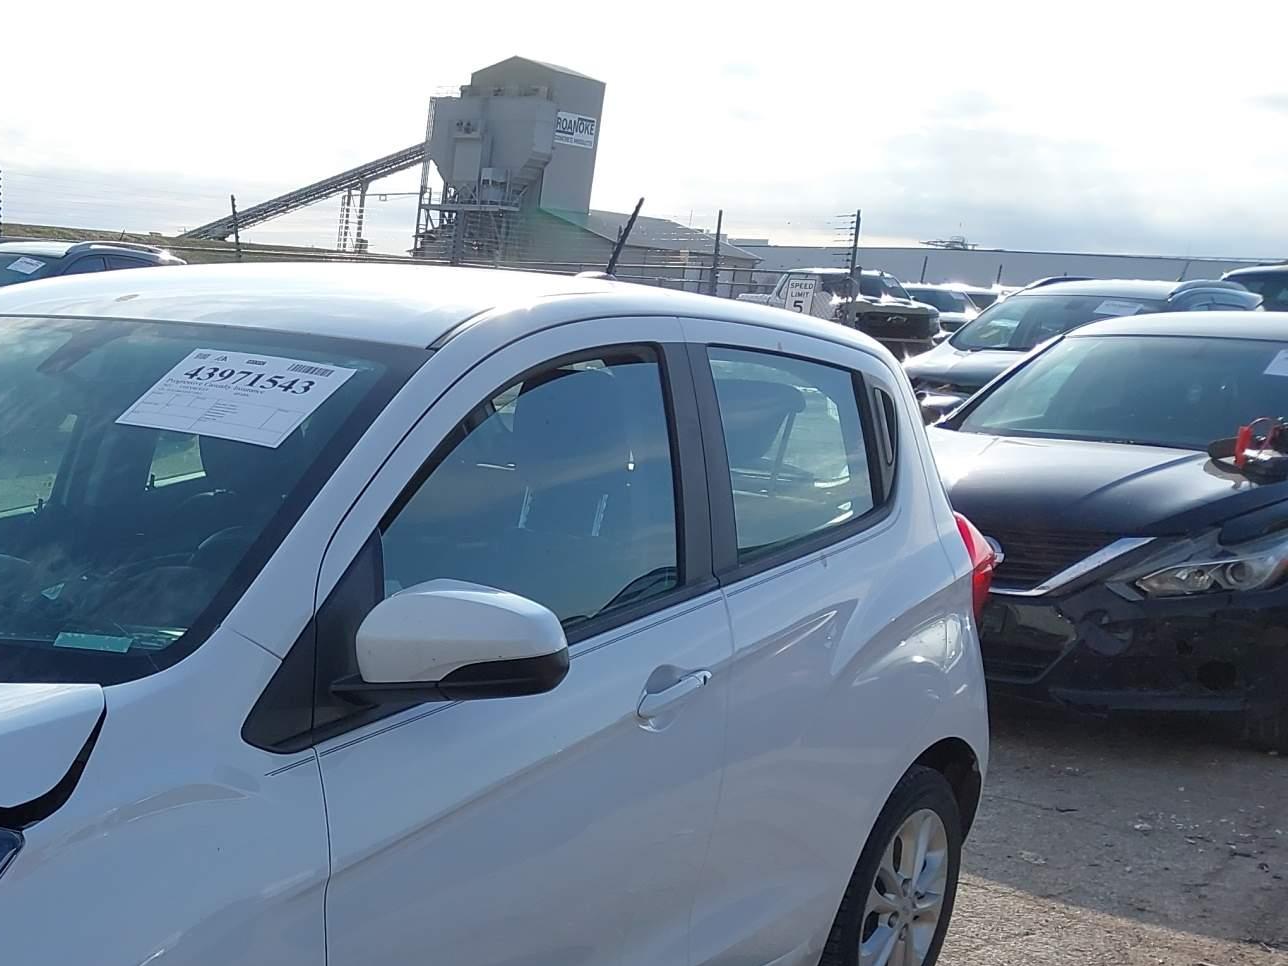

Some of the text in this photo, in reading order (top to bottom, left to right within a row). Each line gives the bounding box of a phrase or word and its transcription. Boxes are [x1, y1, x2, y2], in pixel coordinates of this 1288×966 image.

[556, 117, 594, 135] ROANOKE
[793, 300, 803, 313] 5
[184, 365, 315, 395] 43971543
